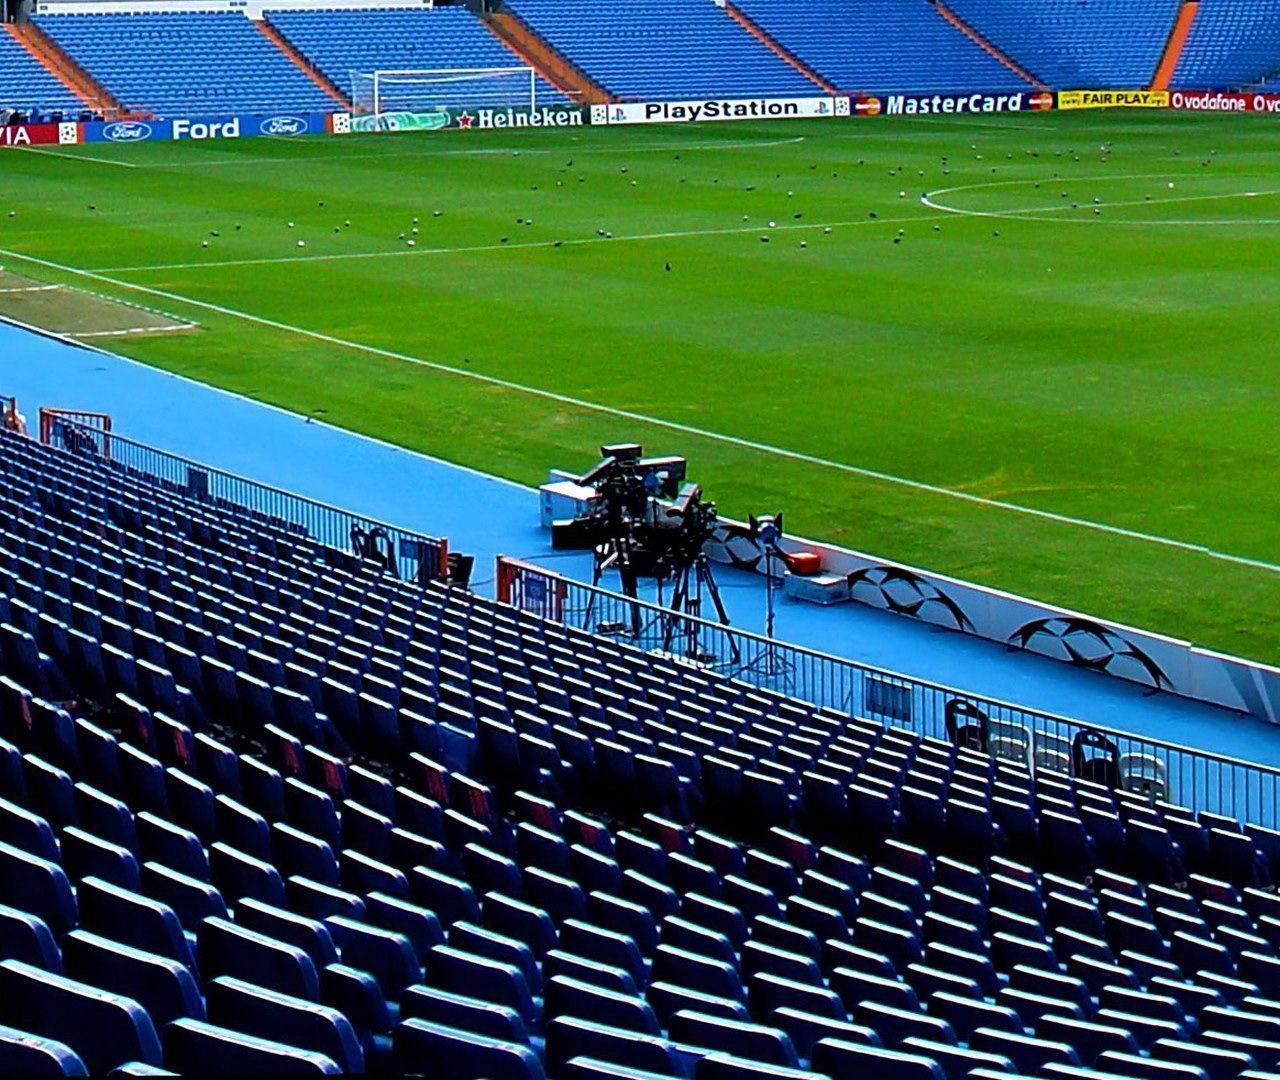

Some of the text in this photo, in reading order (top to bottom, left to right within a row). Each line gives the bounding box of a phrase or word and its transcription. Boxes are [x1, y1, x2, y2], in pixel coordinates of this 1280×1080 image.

[886, 93, 1022, 114] MasterCard
[1082, 94, 1112, 105] FAIR
[1116, 93, 1150, 104] PLAY
[1183, 94, 1246, 111] vodafone
[478, 108, 583, 128] Heineken
[645, 100, 798, 122] PlayStation
[173, 118, 240, 139] Ford
